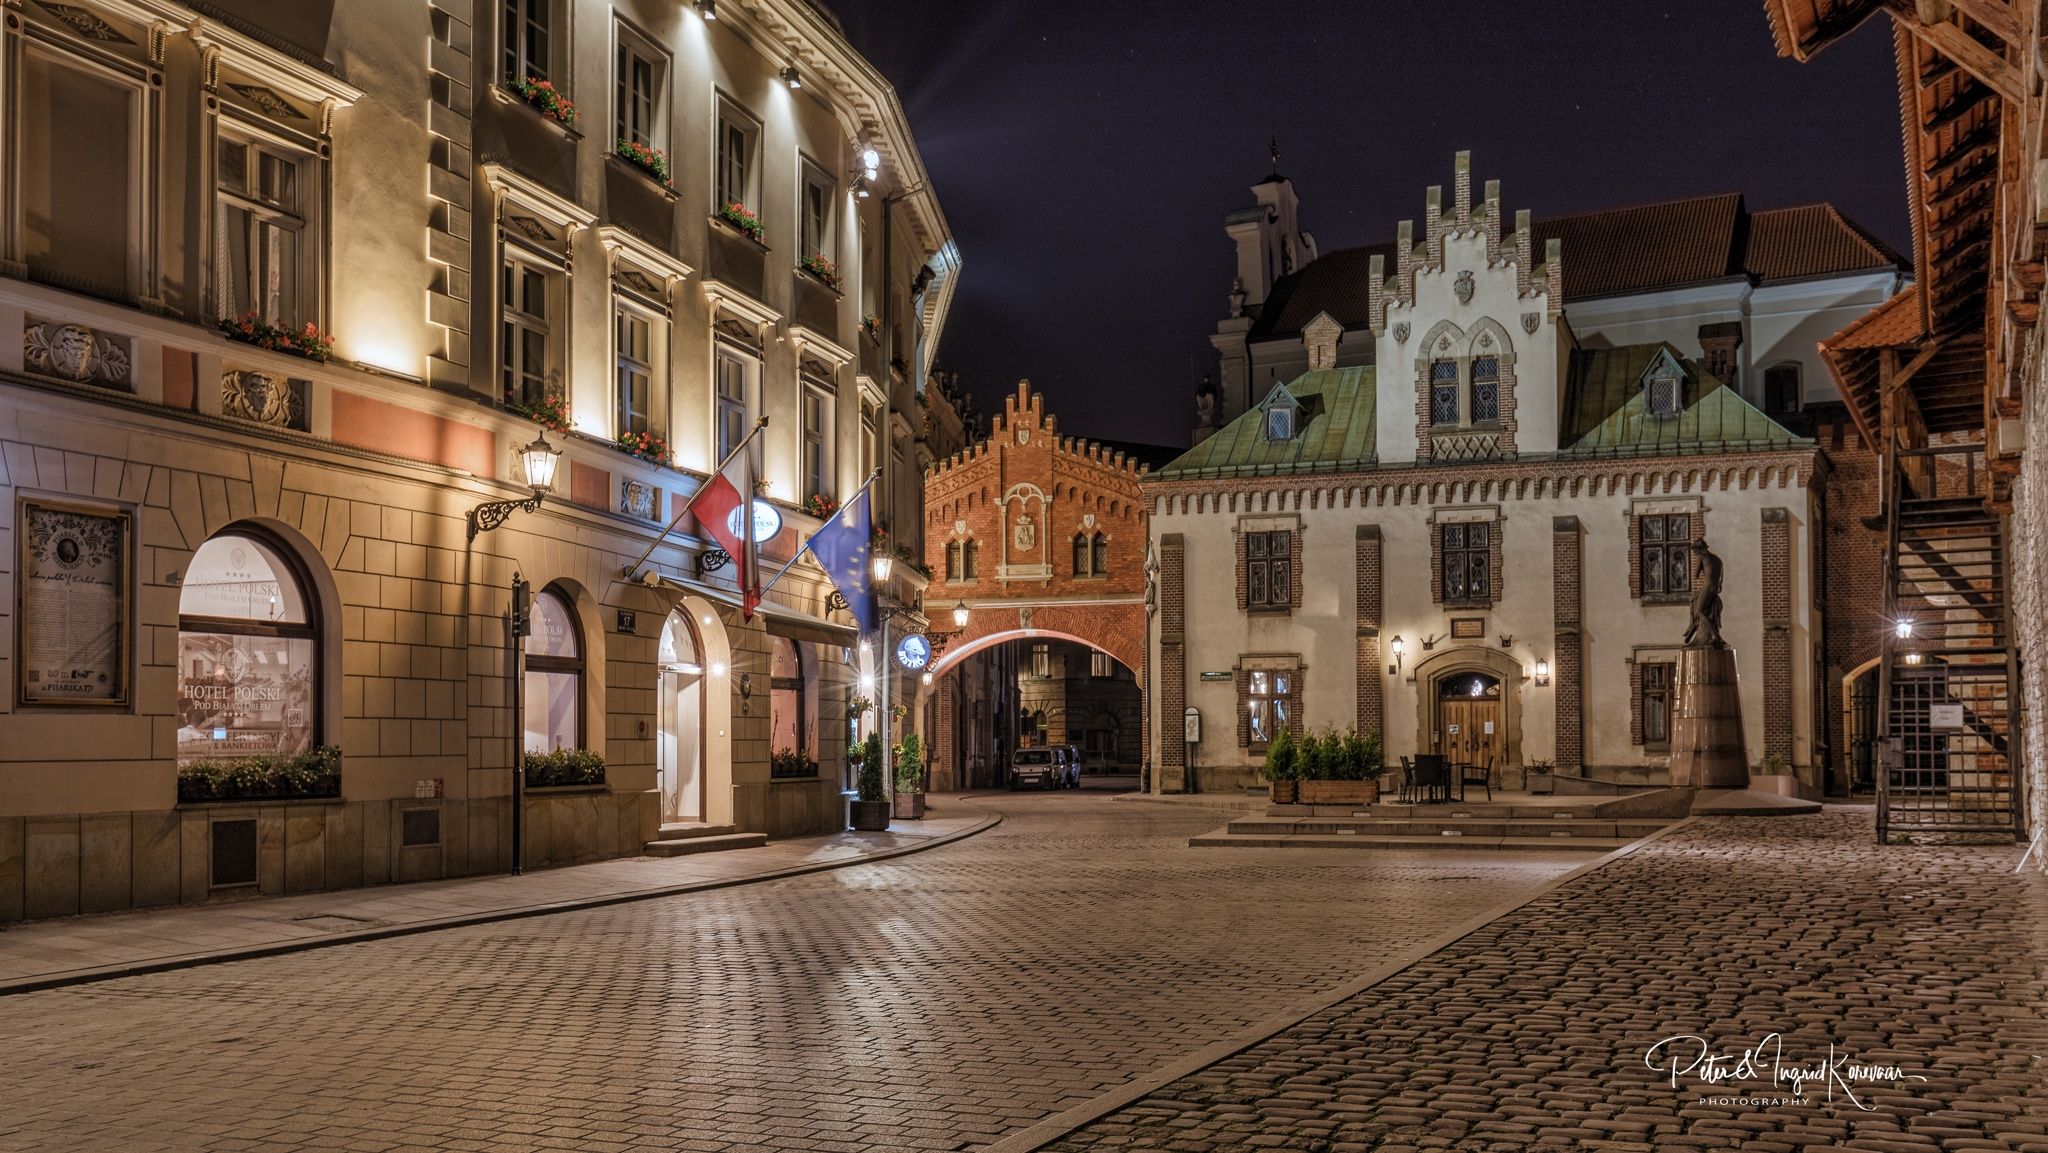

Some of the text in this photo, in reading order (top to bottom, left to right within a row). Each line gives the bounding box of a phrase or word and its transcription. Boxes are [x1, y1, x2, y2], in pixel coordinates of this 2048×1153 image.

[195, 576, 279, 597] HOTEL POLSKI
[623, 616, 631, 626] 17
[898, 650, 925, 668] BISTRO
[47, 683, 83, 693] PIJARSKA
[183, 685, 281, 701] HOTEL POLSKI
[194, 701, 210, 710] POD
